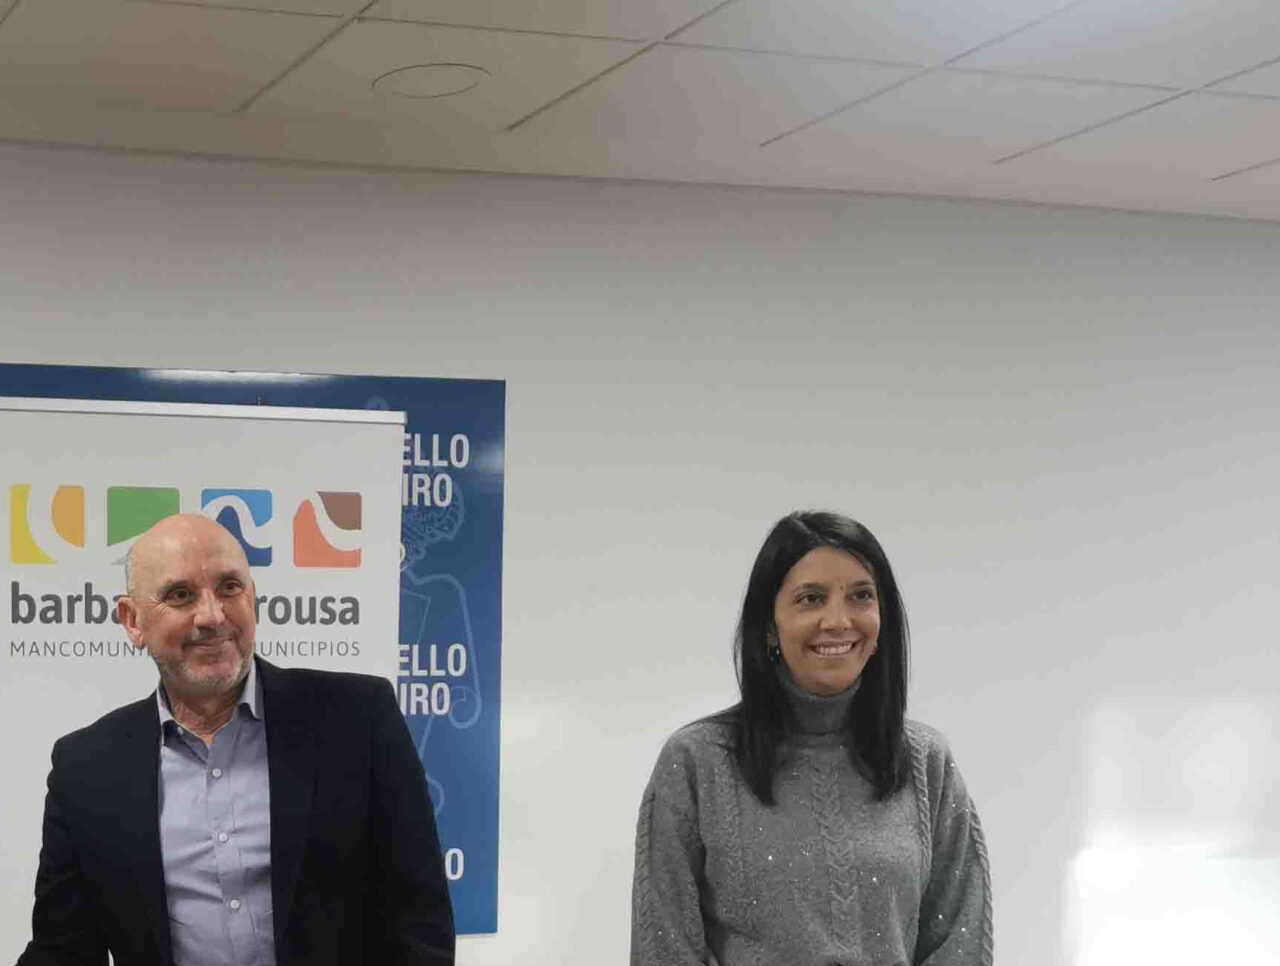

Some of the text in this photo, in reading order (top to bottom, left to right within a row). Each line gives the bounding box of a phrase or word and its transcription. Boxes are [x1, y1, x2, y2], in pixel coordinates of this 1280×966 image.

[403, 433, 470, 468] ELLO
[402, 473, 453, 507] IRO
[255, 594, 360, 625] rousa
[259, 640, 361, 656] UNICIPIOS
[397, 643, 467, 677] ELLO
